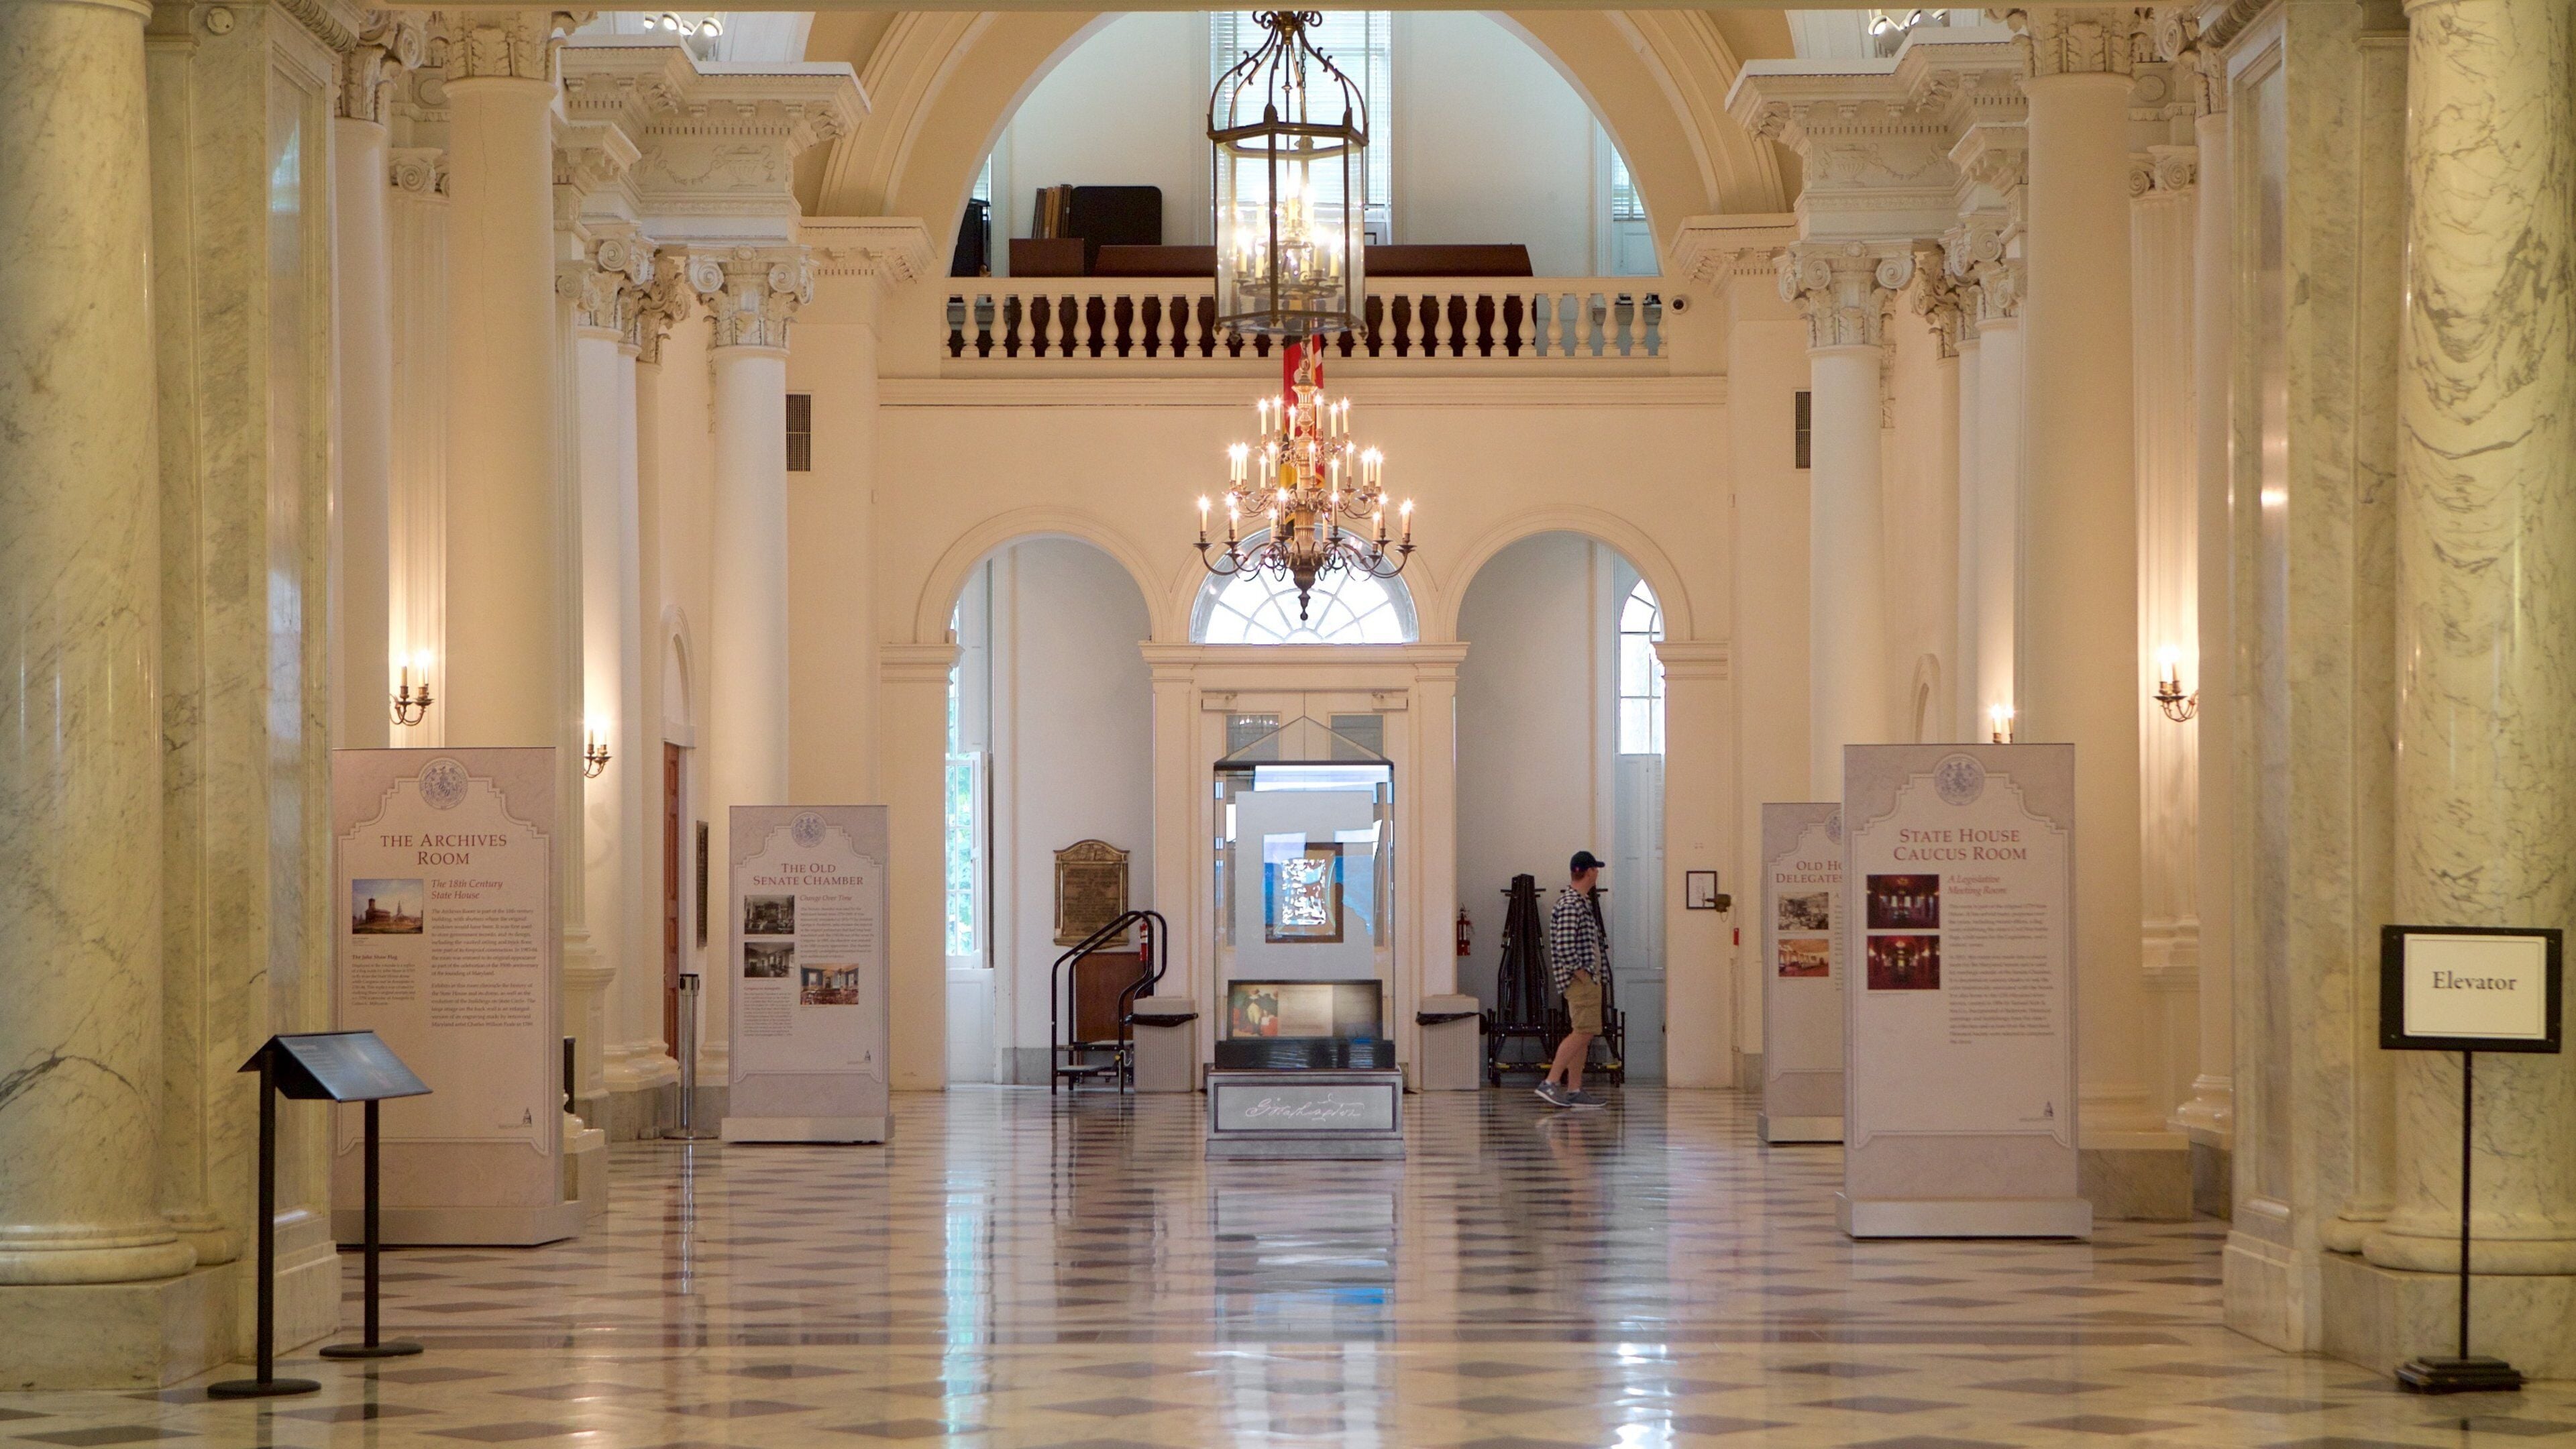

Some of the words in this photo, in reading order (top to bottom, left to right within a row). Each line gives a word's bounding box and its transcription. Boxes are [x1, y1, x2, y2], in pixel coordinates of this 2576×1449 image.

[380, 835, 413, 847] THE
[421, 833, 506, 847] ARCHIVES
[1899, 828, 1952, 843] STATE
[1960, 828, 2020, 843] HOUSE
[417, 851, 469, 865] ROOM
[1893, 847, 1967, 861] CAUCUS
[1973, 847, 2027, 861] ROOM
[782, 863, 806, 873] THE
[810, 863, 836, 873] OLD
[1796, 861, 1823, 871] OLD
[431, 879, 447, 890] The
[449, 879, 467, 890] 18th
[469, 879, 503, 890] Century
[753, 875, 799, 885] SENATE
[804, 875, 863, 885] CHAMBER
[431, 890, 452, 900] State
[454, 890, 480, 900] House
[2432, 970, 2518, 990] Elevator
